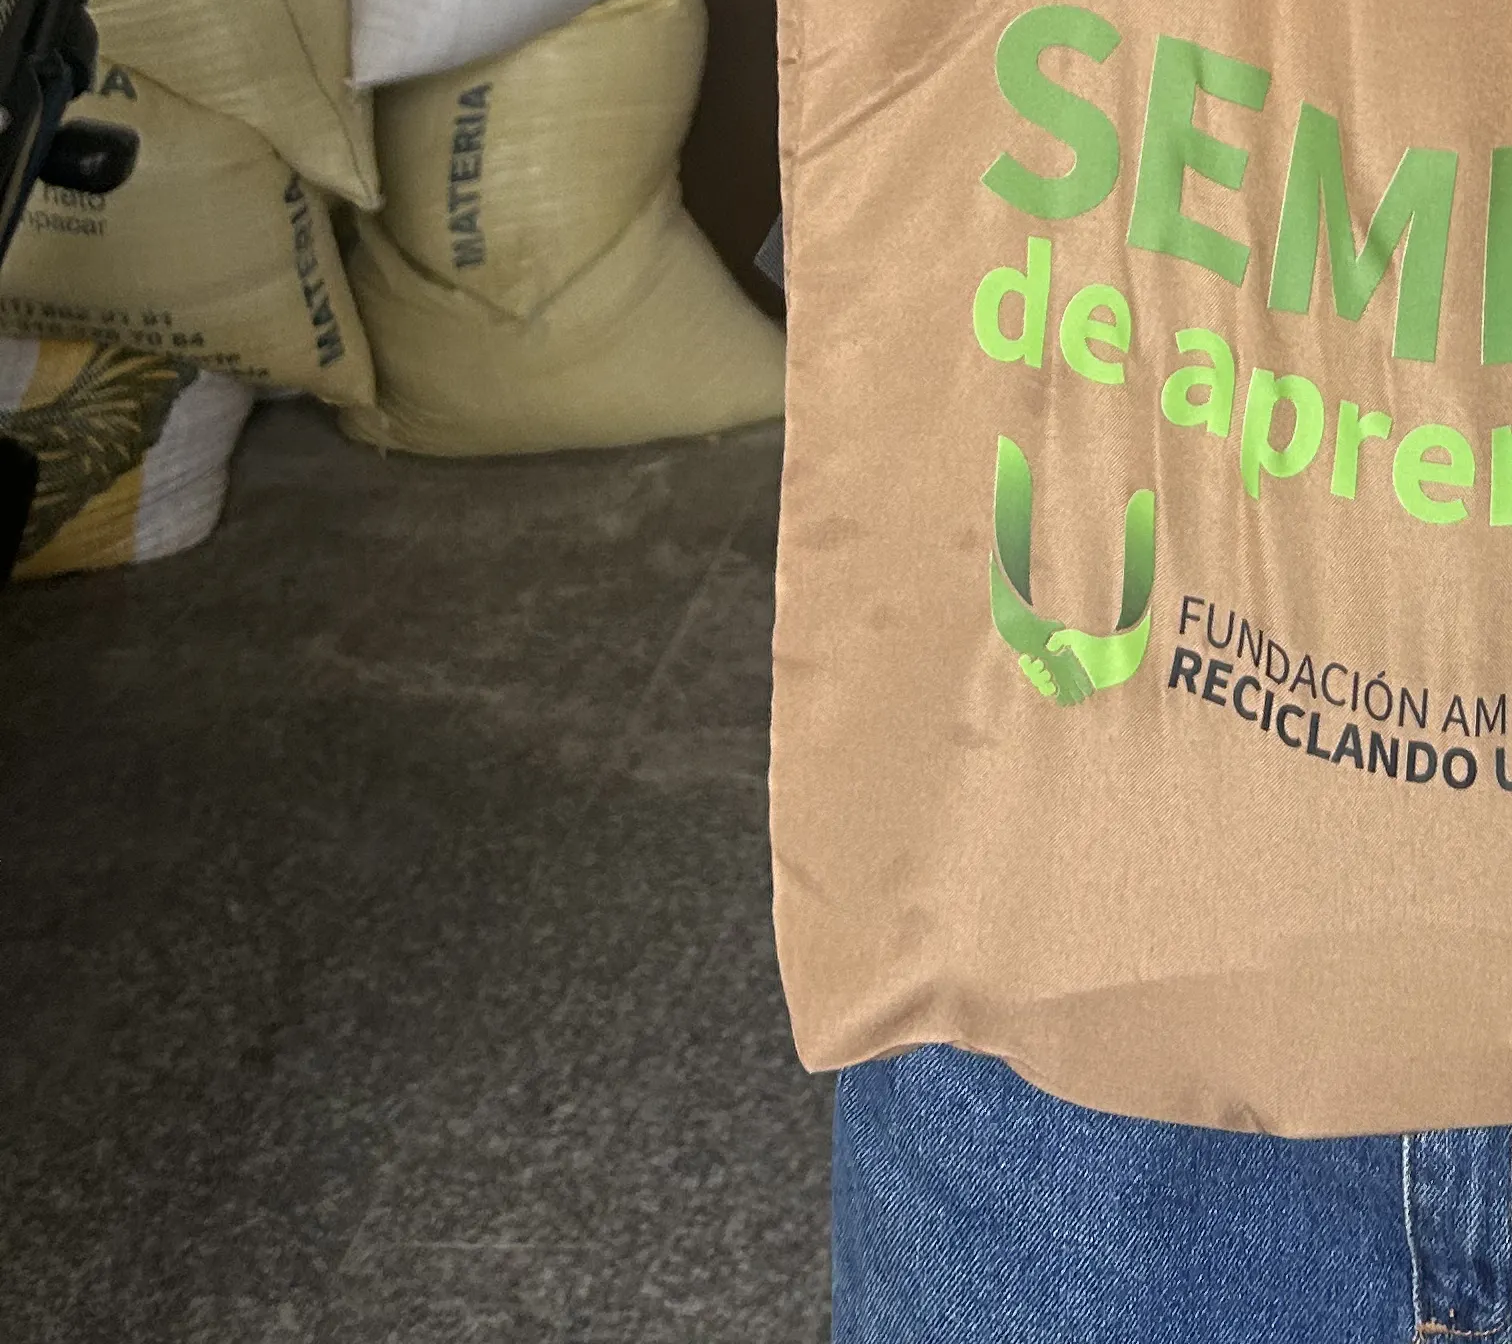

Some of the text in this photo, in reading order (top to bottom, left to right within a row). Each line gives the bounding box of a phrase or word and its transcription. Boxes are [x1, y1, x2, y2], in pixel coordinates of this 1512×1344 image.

[447, 82, 492, 269] MATERIA
[973, 236, 1132, 385] de
[1168, 647, 1477, 790] RECICLANDO
[1179, 595, 1430, 729] FUNDACIÓN
